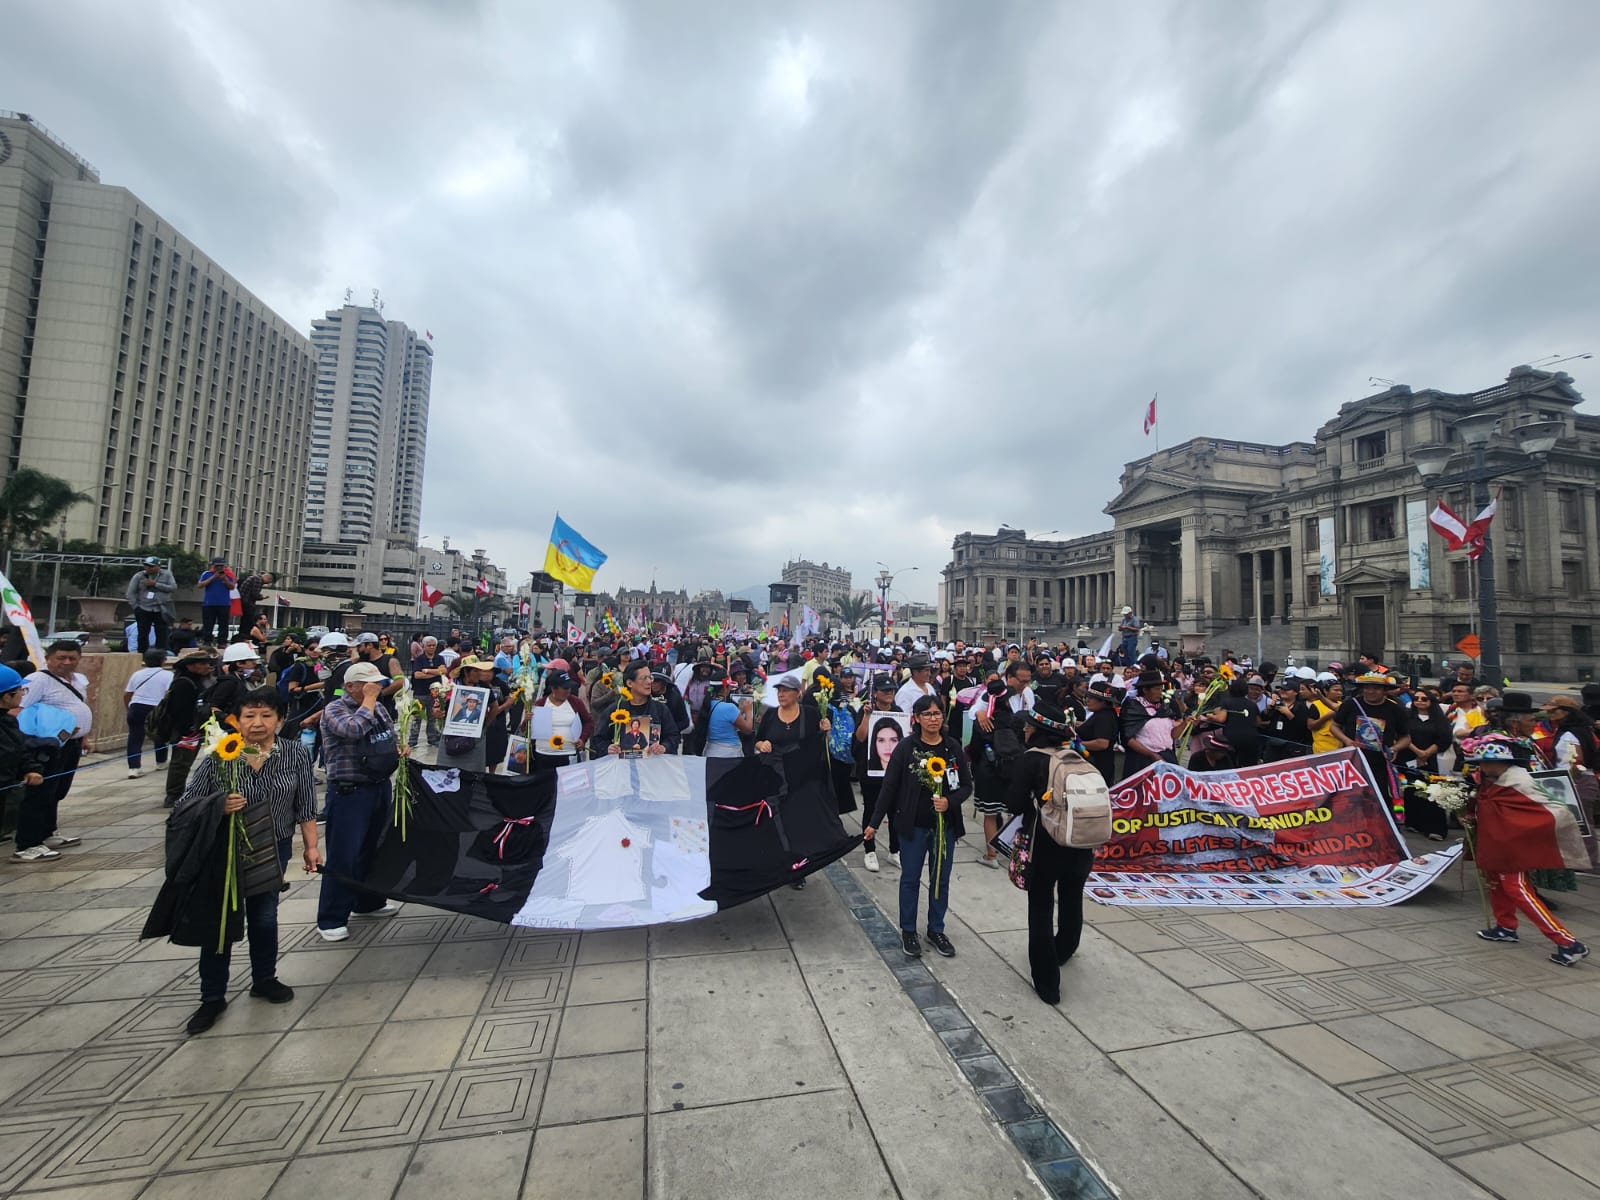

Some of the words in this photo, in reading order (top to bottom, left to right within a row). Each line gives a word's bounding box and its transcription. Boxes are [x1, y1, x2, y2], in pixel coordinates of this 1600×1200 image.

[1142, 771, 1183, 805] NO
[1112, 818, 1143, 834] OR
[1227, 813, 1245, 827] Y
[1129, 840, 1168, 857] LAS
[1173, 835, 1236, 854] LEYES
[1268, 833, 1373, 857] MPUNIDAD
